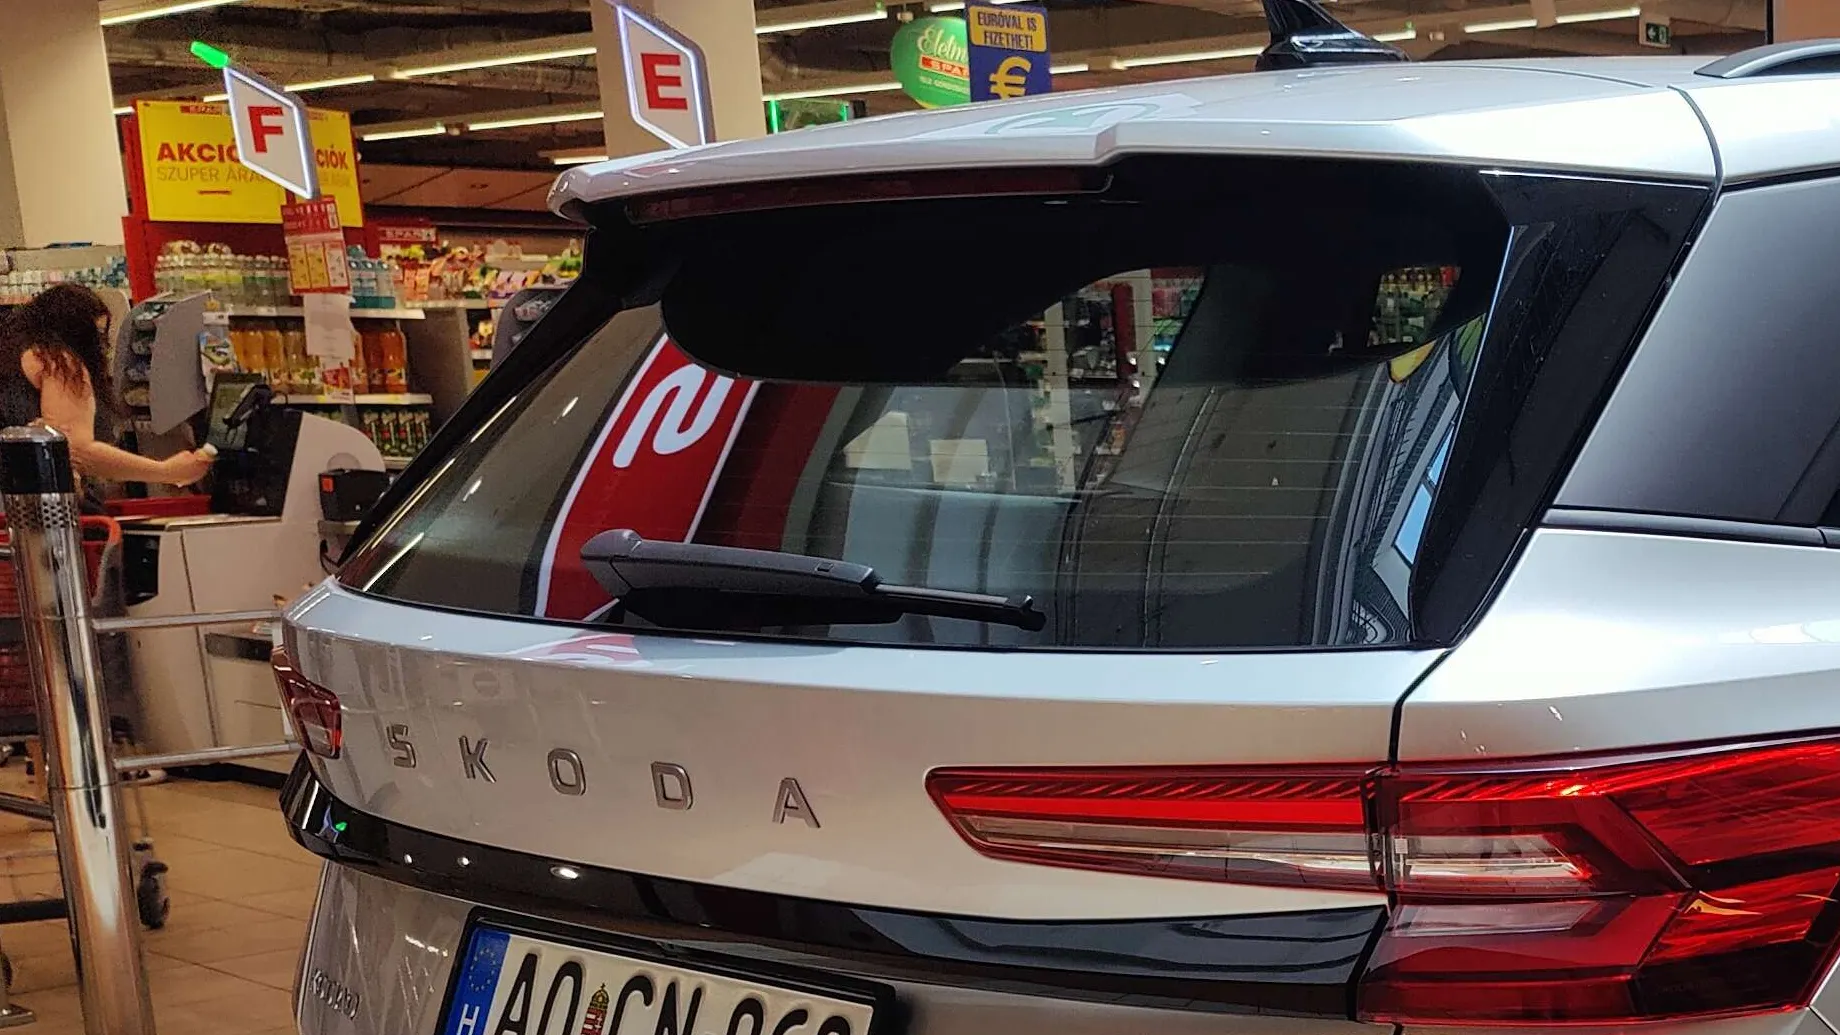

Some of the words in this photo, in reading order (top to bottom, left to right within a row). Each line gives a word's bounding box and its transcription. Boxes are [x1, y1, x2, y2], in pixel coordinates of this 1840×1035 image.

[1026, 17, 1038, 32] IS
[641, 53, 688, 110] E
[247, 106, 284, 153] F
[157, 138, 240, 164] AKCIÓ
[156, 166, 221, 182] SZUPER
